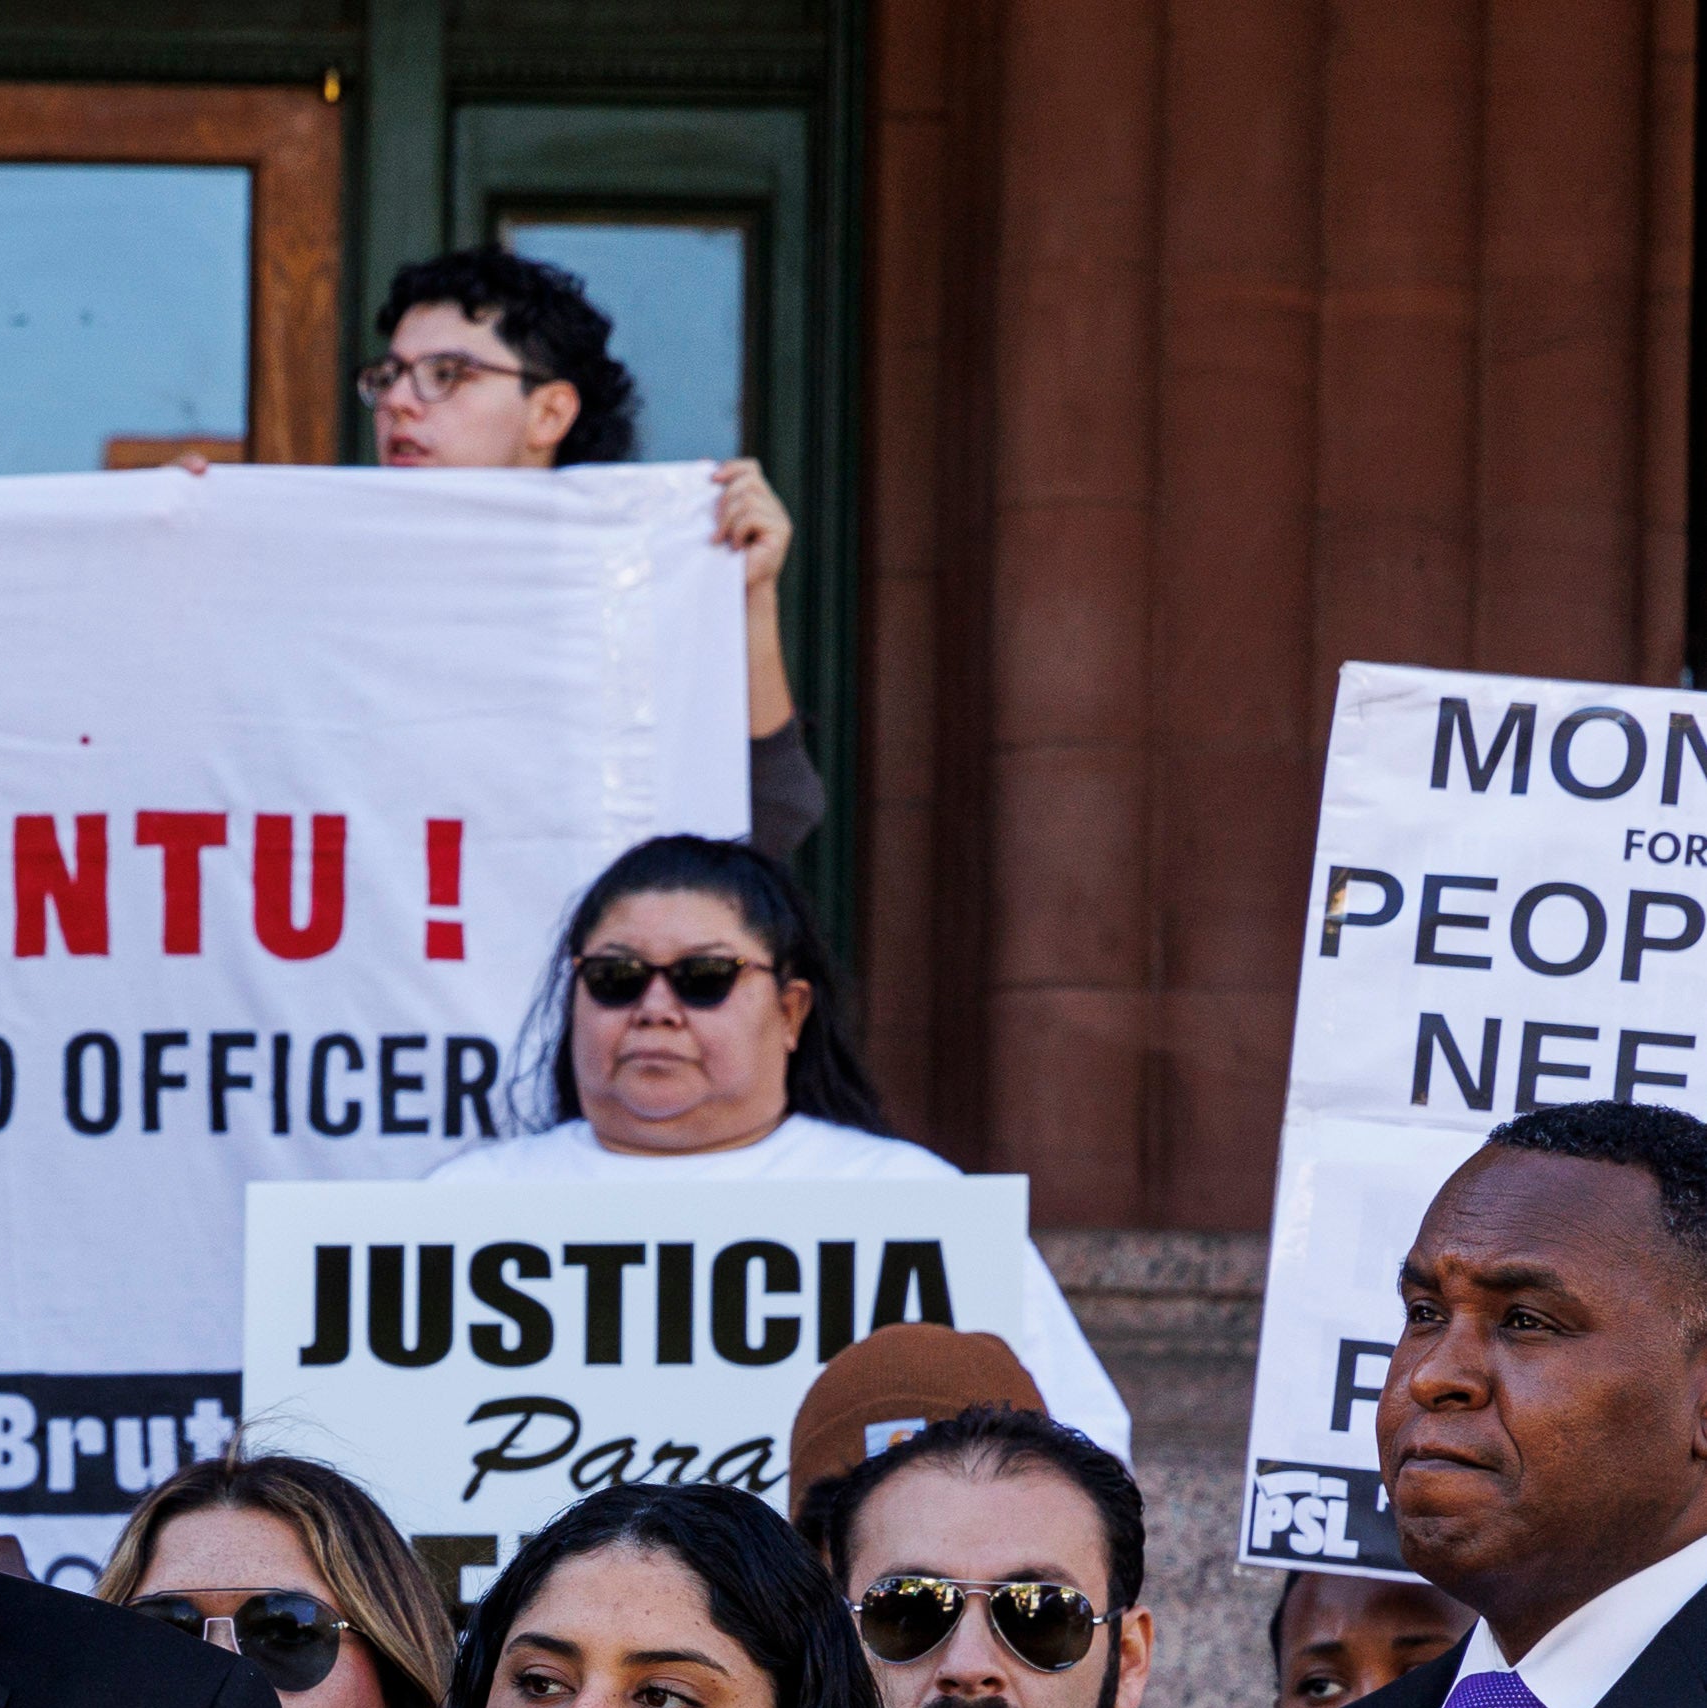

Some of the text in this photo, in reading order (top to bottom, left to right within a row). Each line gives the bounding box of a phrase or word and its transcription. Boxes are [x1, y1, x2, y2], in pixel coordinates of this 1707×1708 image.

[1623, 829, 1707, 867] FOR
[1319, 866, 1707, 982] PEOP
[64, 1029, 499, 1139] OFFICER
[299, 1239, 958, 1368] JUSTICIA
[462, 1395, 789, 1502] Para
[1251, 1496, 1360, 1559] PSL
